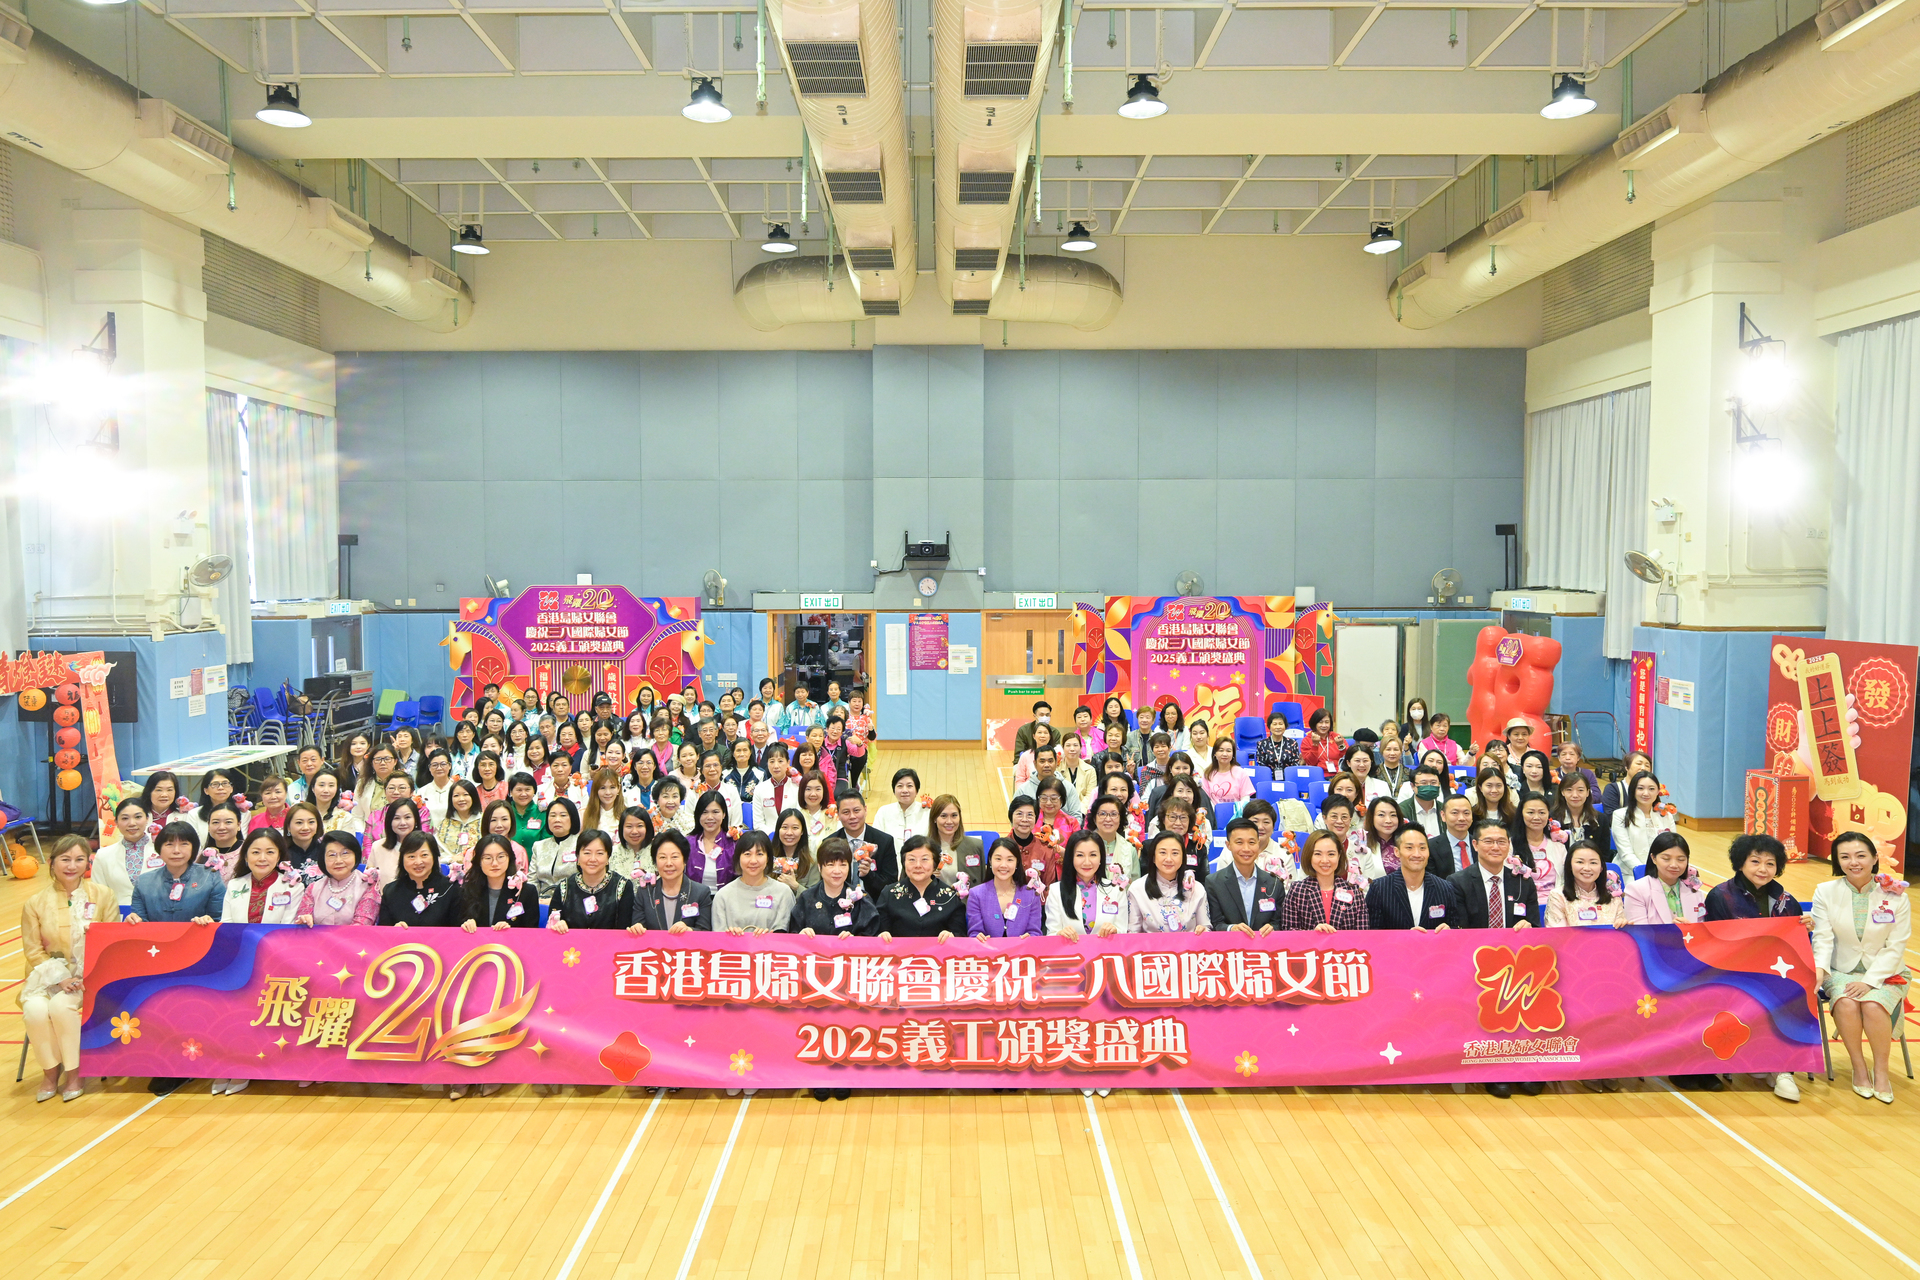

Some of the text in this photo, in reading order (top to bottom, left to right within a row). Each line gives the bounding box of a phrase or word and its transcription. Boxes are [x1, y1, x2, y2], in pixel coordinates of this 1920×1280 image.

[581, 588, 615, 610] 20
[804, 597, 839, 607] EXIT 出口
[1019, 597, 1053, 607] EXIT 出口
[537, 611, 617, 625] 香港島婦女聯會
[1203, 602, 1231, 620] 20
[525, 626, 629, 639] 慶祝三八國際婦女節
[1157, 623, 1239, 635] 香港島婦女聯會
[530, 641, 625, 653] 2025義工頒獎盛典
[1145, 637, 1250, 650] 慶祝三八國際婦女節
[1150, 652, 1246, 664] 2025義工頒獎盛典
[1808, 655, 1823, 664] 2026
[1864, 679, 1891, 710] 發
[1774, 717, 1793, 743] 財
[614, 949, 1370, 1003] 香港島婦女聯會慶祝三八國際婦女節
[250, 943, 532, 1066] 飛躍 20
[796, 1017, 1188, 1065] 2025義工頒獎盛典
[1463, 1036, 1580, 1057] 香港島婦女聯會
